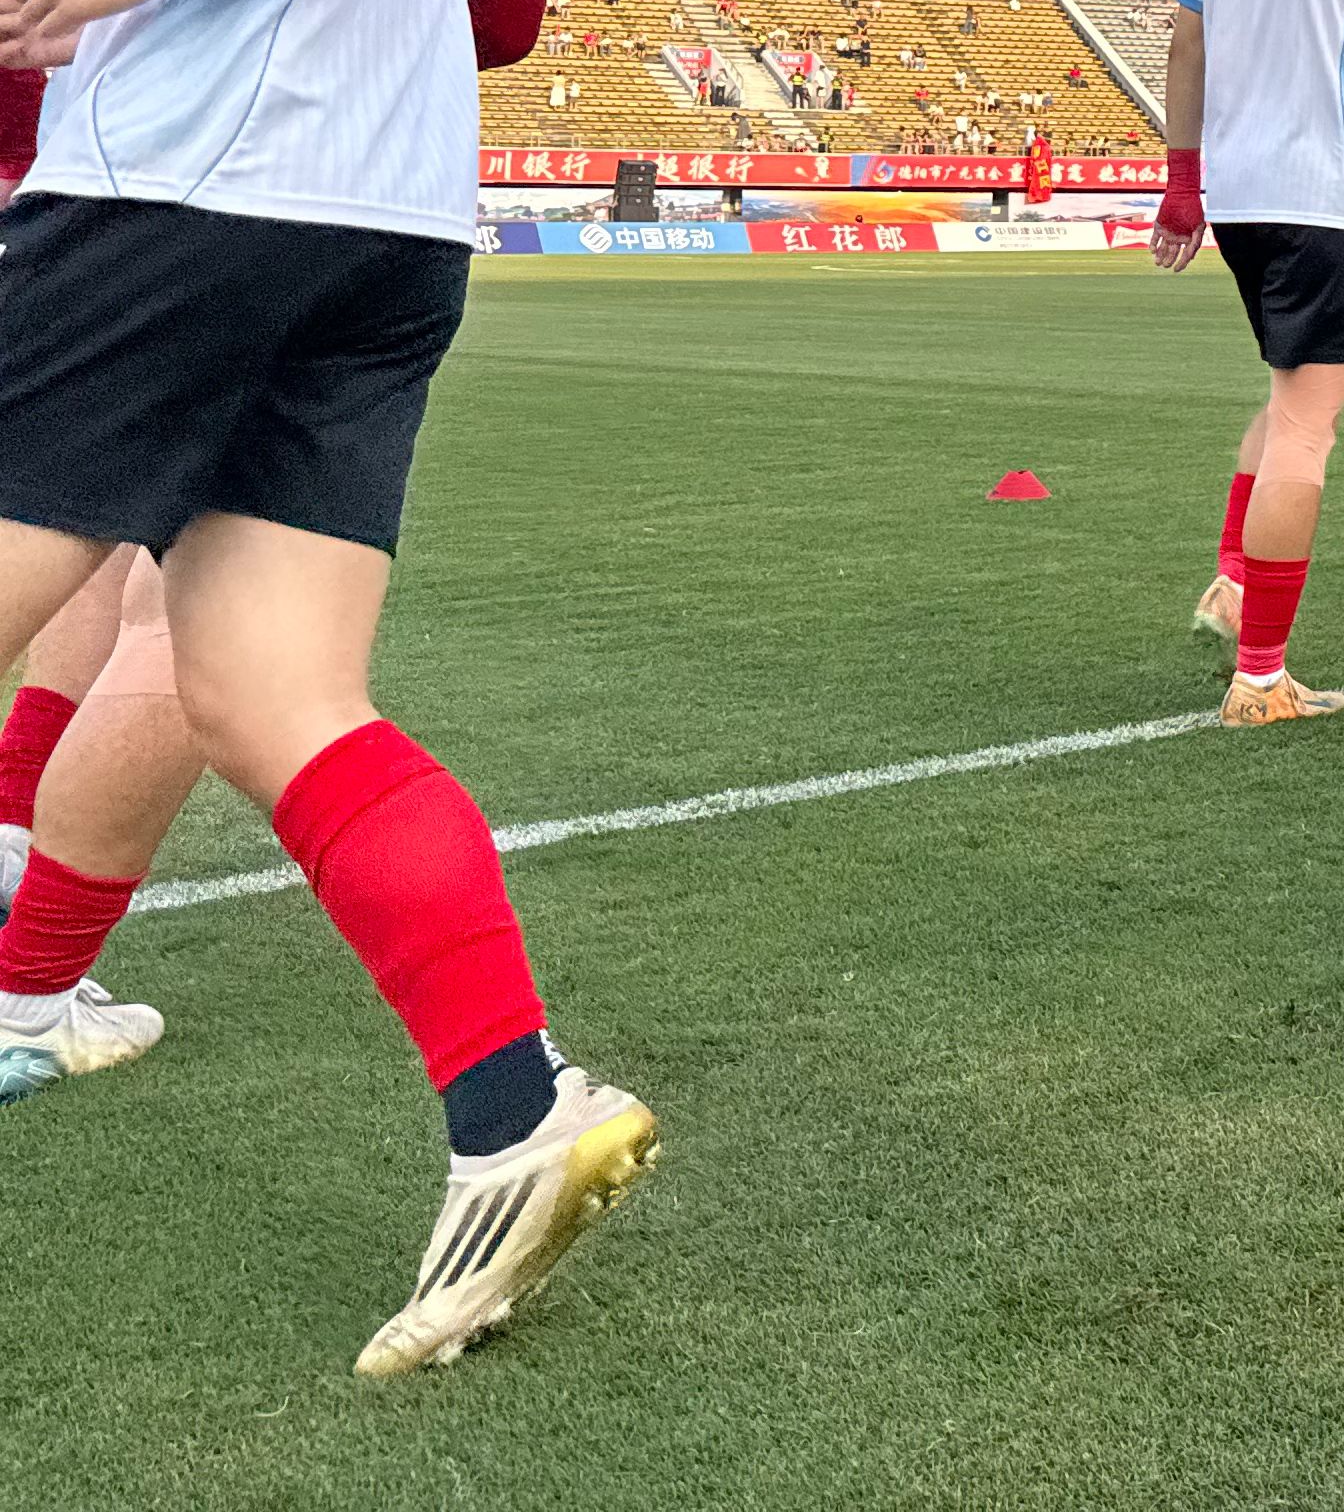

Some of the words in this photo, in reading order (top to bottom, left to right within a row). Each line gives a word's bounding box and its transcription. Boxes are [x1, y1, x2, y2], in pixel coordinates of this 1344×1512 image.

[487, 151, 592, 181] 川银行
[636, 152, 756, 182] 超很行
[616, 226, 716, 251] 中国移动
[781, 224, 907, 253] 红花郎
